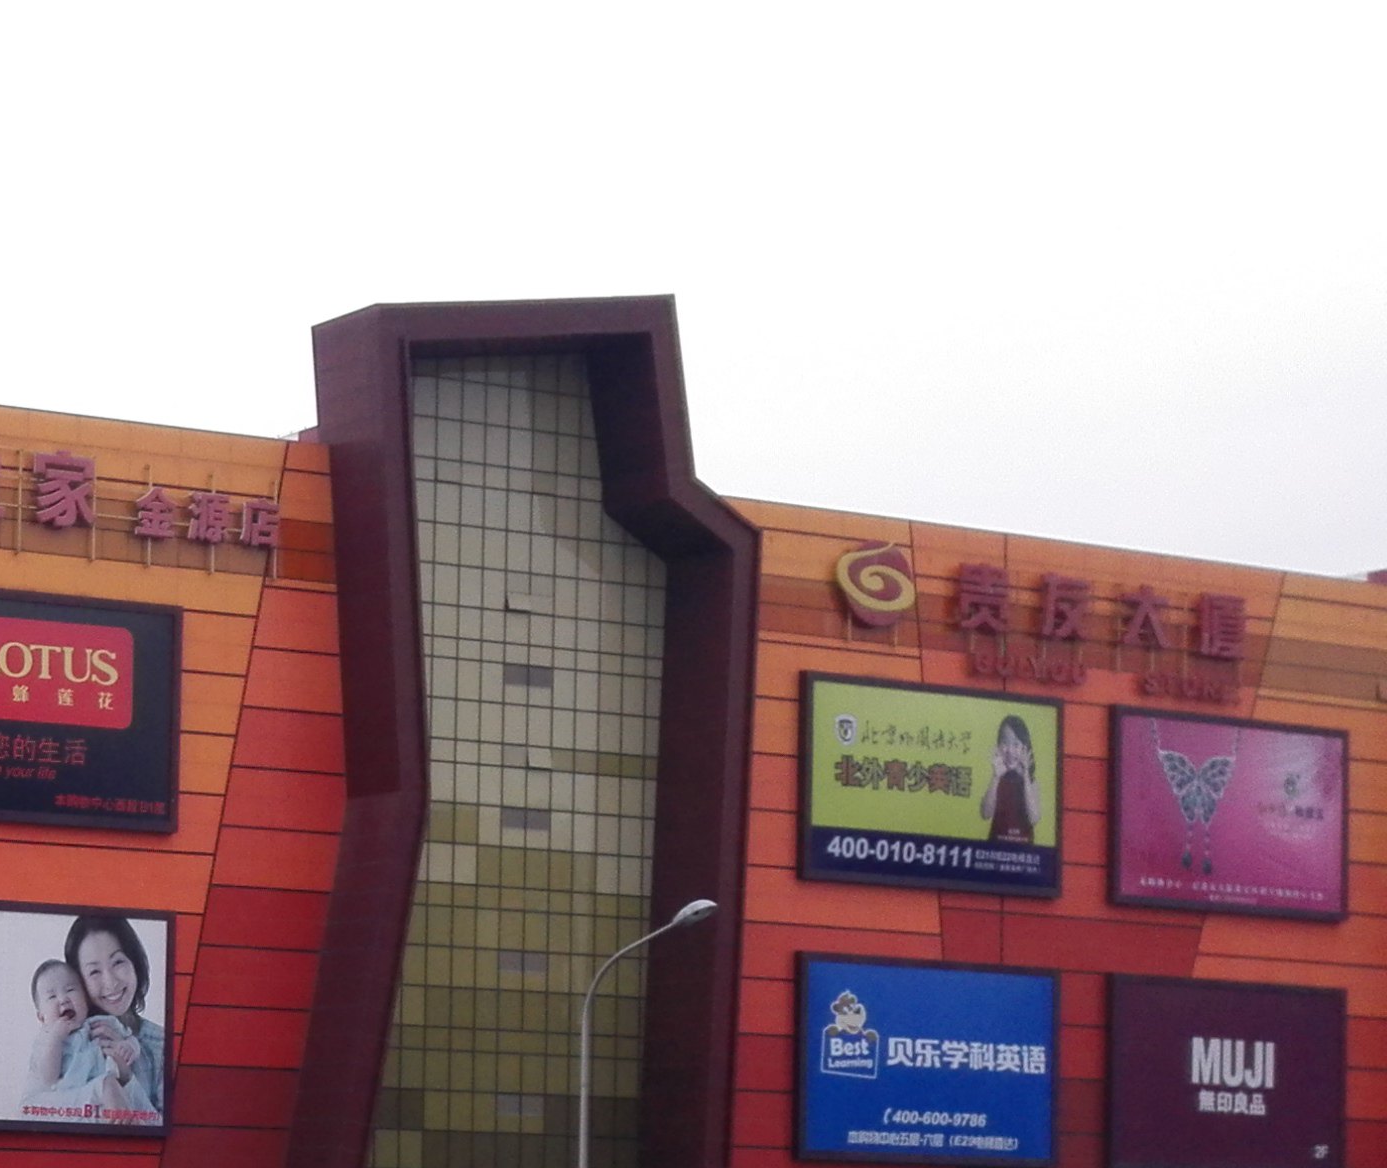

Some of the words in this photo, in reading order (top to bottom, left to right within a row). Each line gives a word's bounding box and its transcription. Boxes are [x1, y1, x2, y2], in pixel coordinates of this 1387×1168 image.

[135, 487, 281, 547] 金源店
[827, 836, 973, 868] 400-010-8111
[830, 1038, 869, 1057] Best
[887, 1037, 1047, 1074] 贝乐学科英语
[1191, 1036, 1275, 1089] MUJI
[894, 1109, 987, 1128] 400-600-9786
